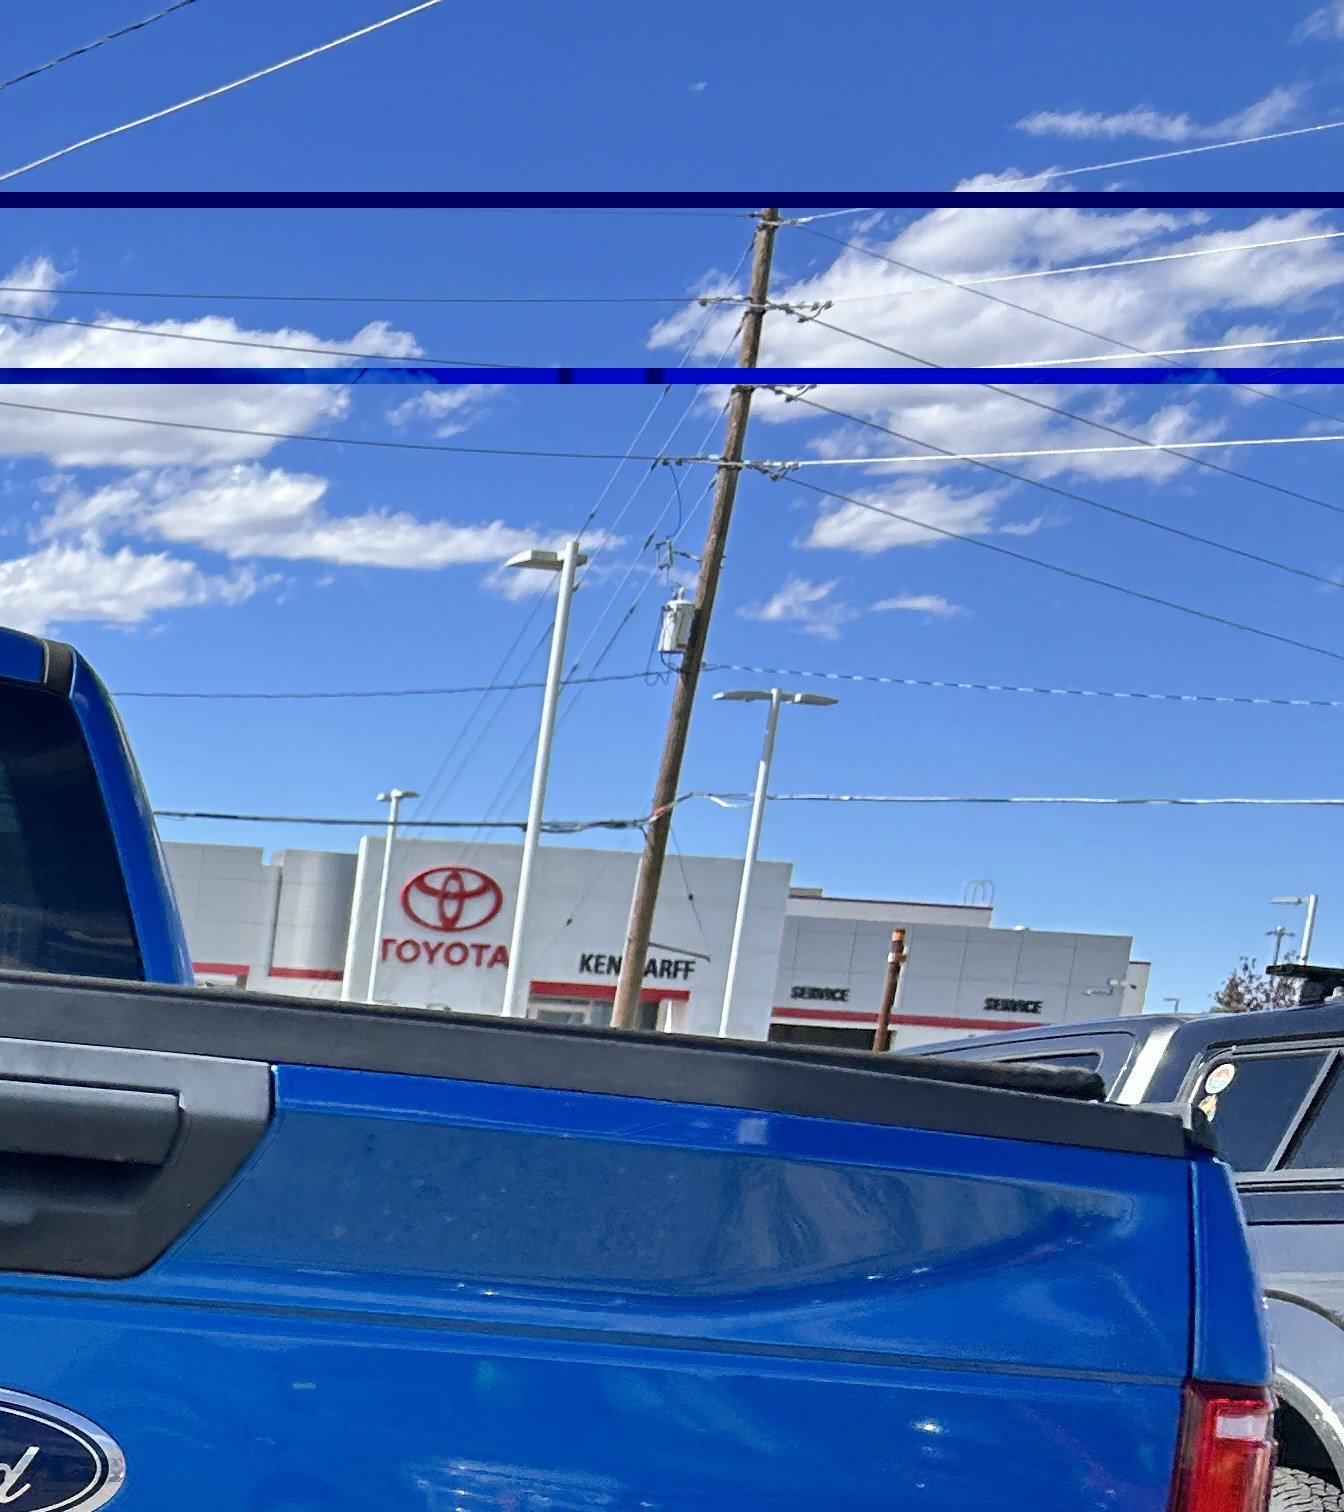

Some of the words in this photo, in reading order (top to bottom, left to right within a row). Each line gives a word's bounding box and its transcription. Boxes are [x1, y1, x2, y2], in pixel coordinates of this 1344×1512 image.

[381, 937, 510, 969] TOYOTA
[579, 952, 623, 976] KEN
[643, 957, 697, 981] ARFF
[791, 985, 850, 1002] SERVICE
[983, 997, 1044, 1014] SERVICE
